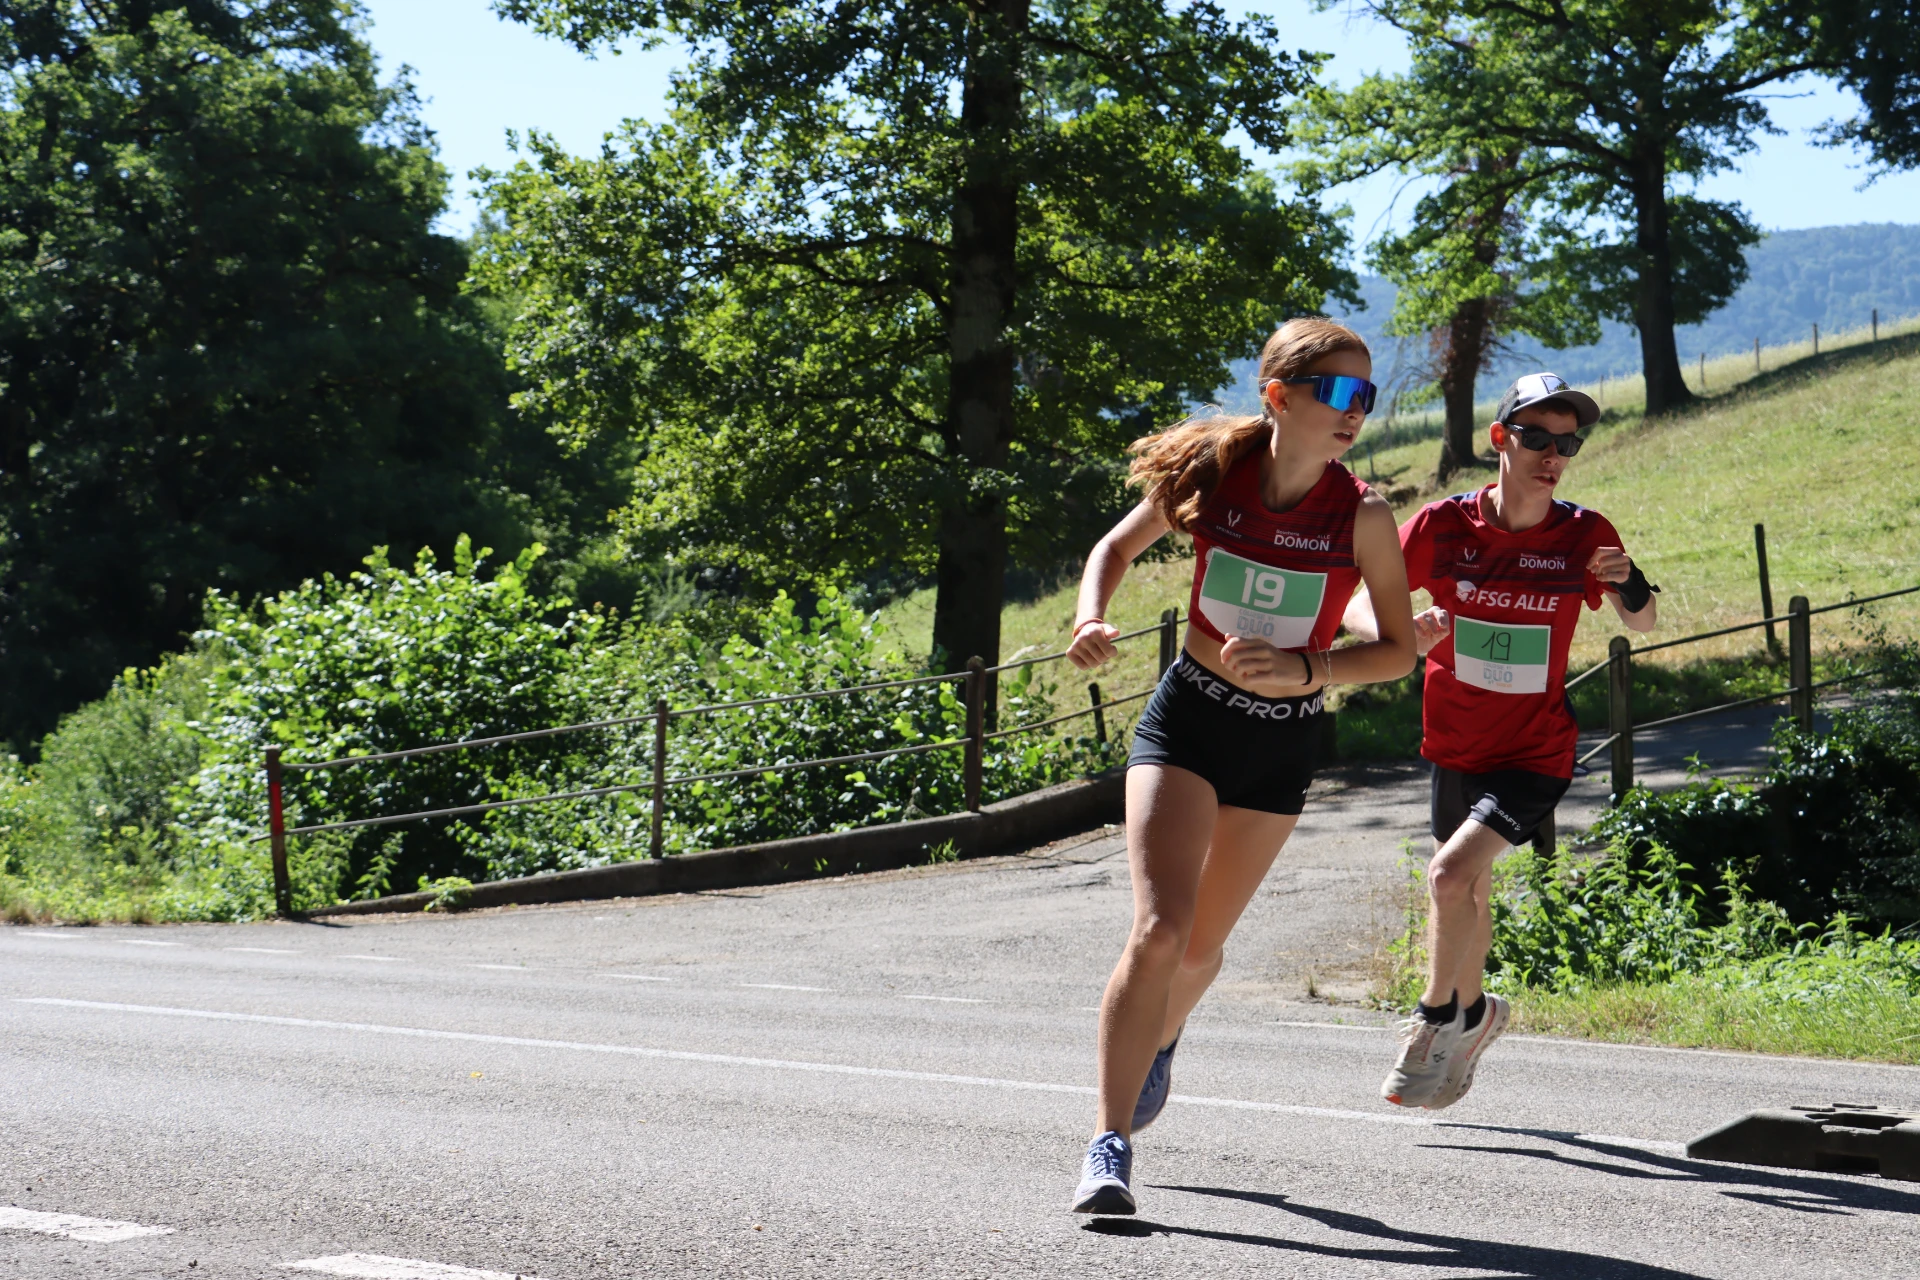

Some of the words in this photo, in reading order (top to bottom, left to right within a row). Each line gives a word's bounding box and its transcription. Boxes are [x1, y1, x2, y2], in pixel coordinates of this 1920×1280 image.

[1274, 534, 1330, 552] DOMON
[1519, 557, 1565, 570] DOMON
[1241, 566, 1286, 610] 19
[1476, 589, 1512, 608] FSG
[1513, 594, 1560, 612] ALLE
[1236, 615, 1275, 637] DUO
[1481, 630, 1511, 662] 19
[1483, 667, 1513, 683] DUO
[1174, 654, 1229, 701] NIKE
[1226, 693, 1292, 720] PRO
[1492, 807, 1518, 827] CRAFT
